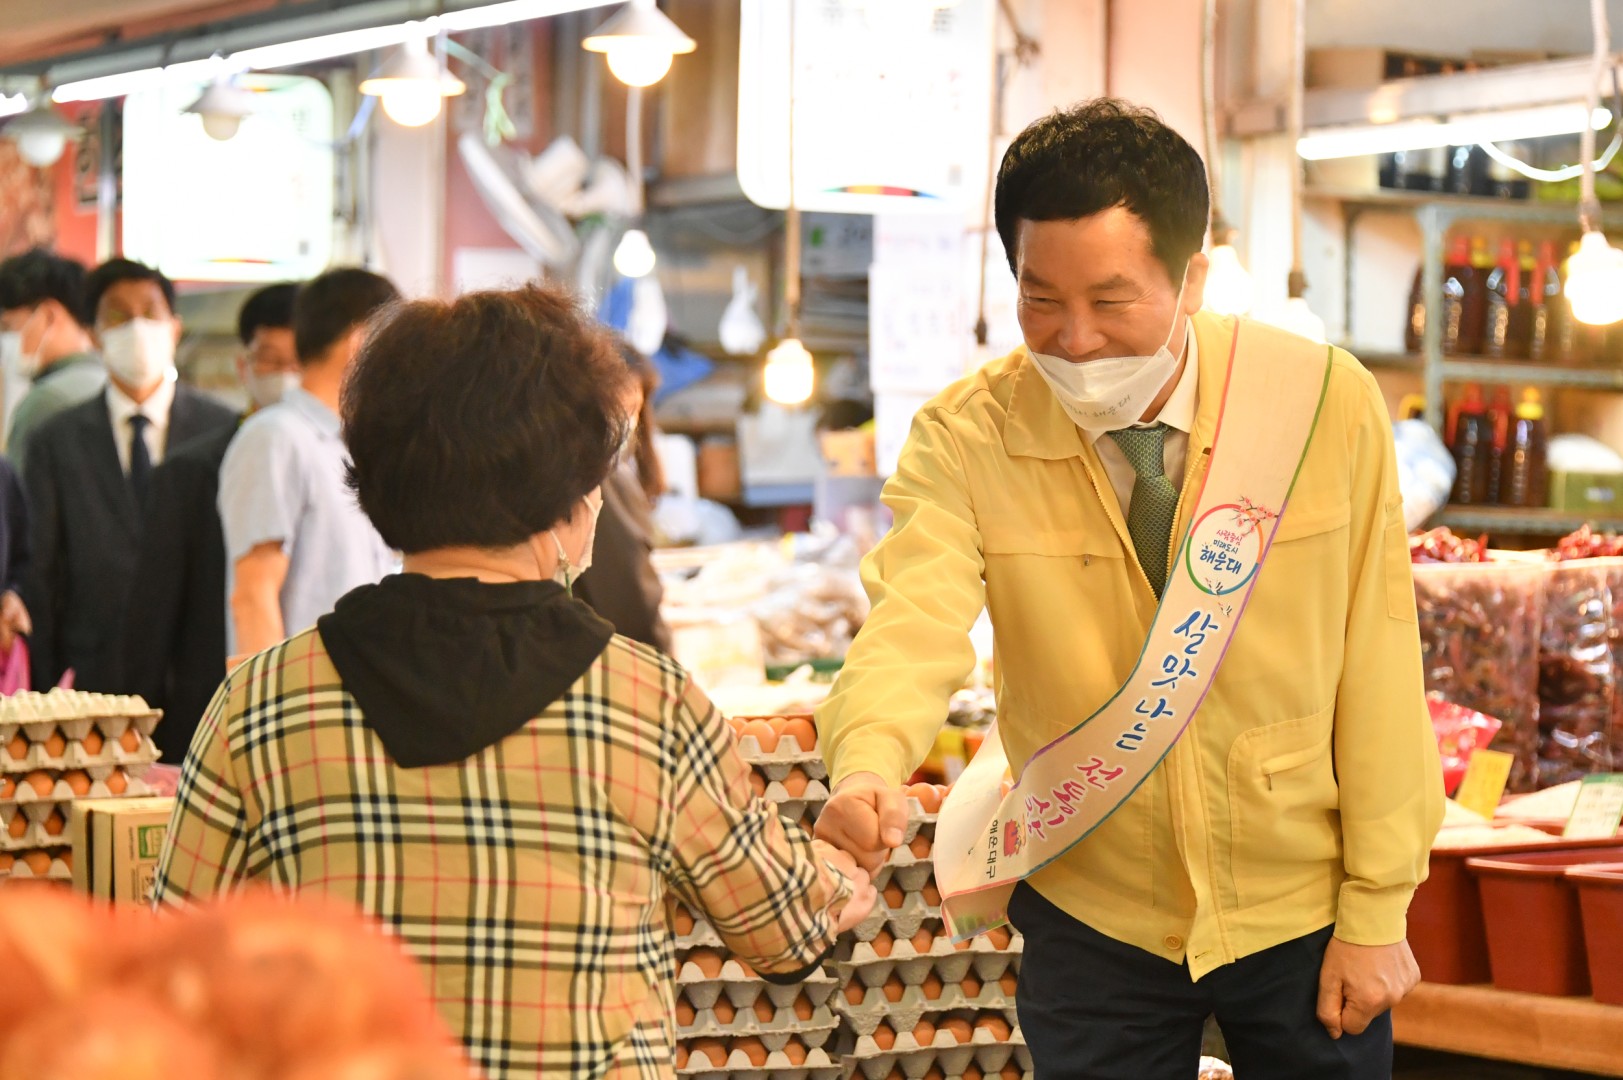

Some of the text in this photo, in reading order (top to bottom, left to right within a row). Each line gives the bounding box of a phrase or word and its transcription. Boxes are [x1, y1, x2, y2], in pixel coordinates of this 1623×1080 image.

[1213, 539, 1239, 554] 미래도시
[1216, 529, 1243, 546] 사람중심
[1199, 546, 1242, 574] 해운대
[986, 819, 999, 879] 해운대구
